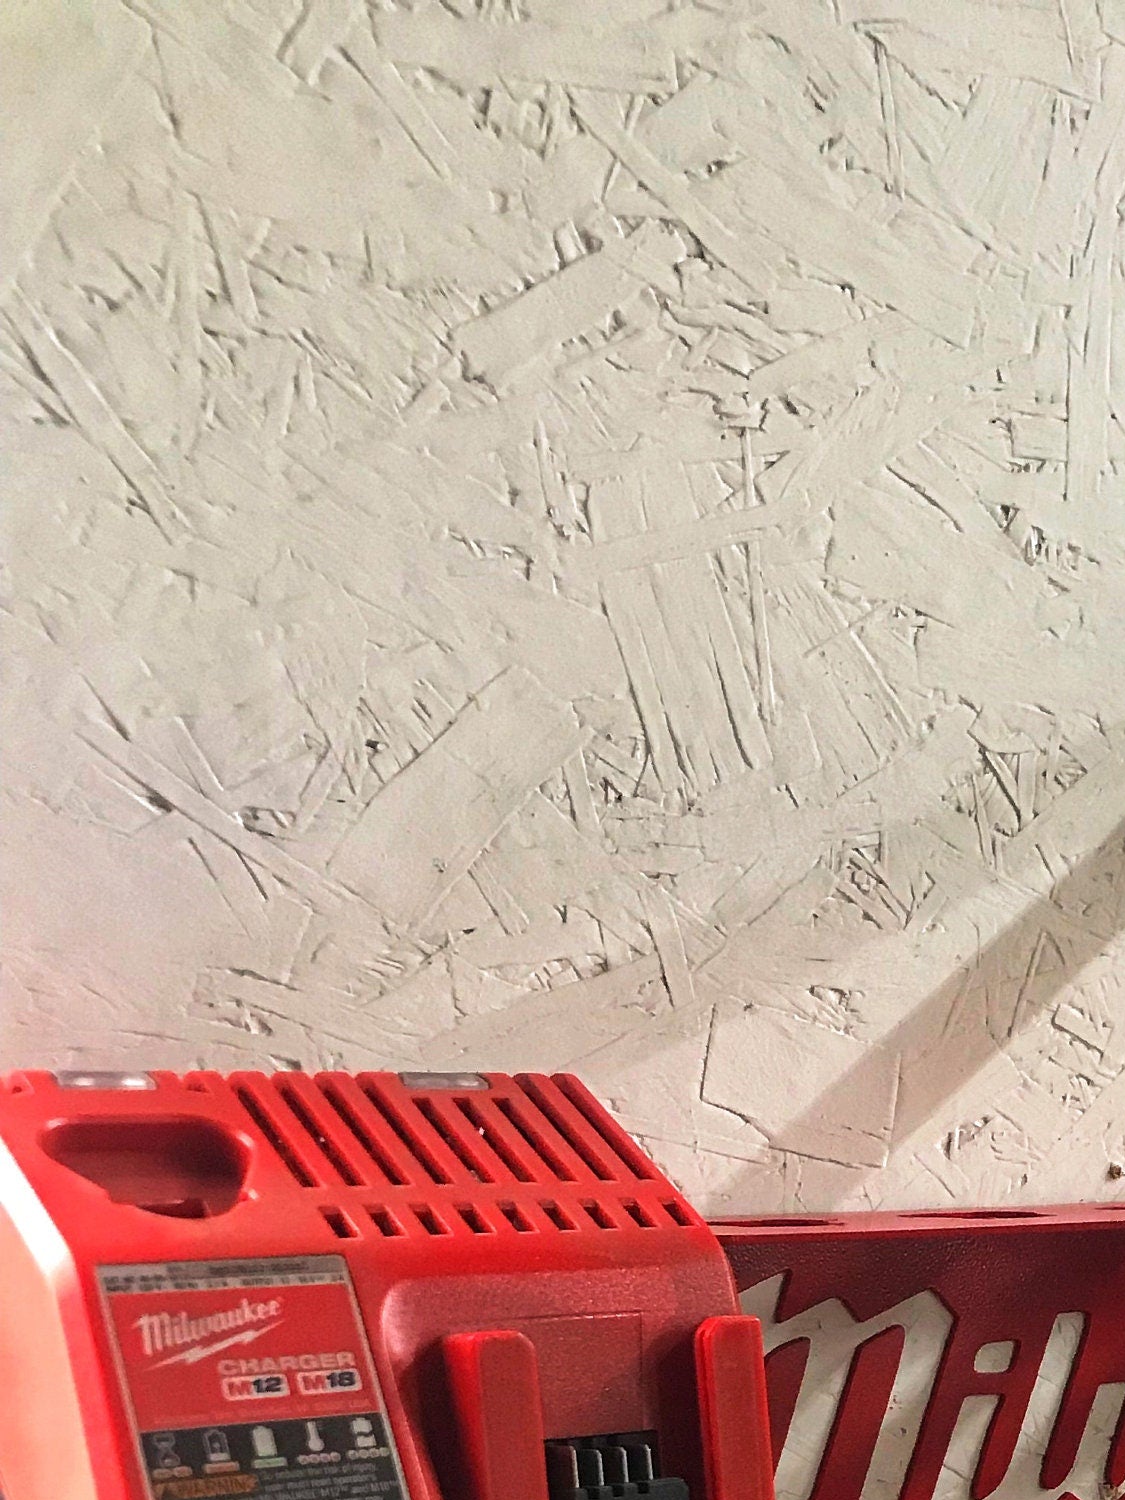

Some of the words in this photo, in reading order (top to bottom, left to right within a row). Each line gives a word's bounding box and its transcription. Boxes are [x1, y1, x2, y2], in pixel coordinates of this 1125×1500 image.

[133, 1298, 282, 1356] Milwaukee
[217, 1352, 357, 1376] CHARGER
[226, 1376, 283, 1397] M12
[302, 1371, 357, 1393] M18
